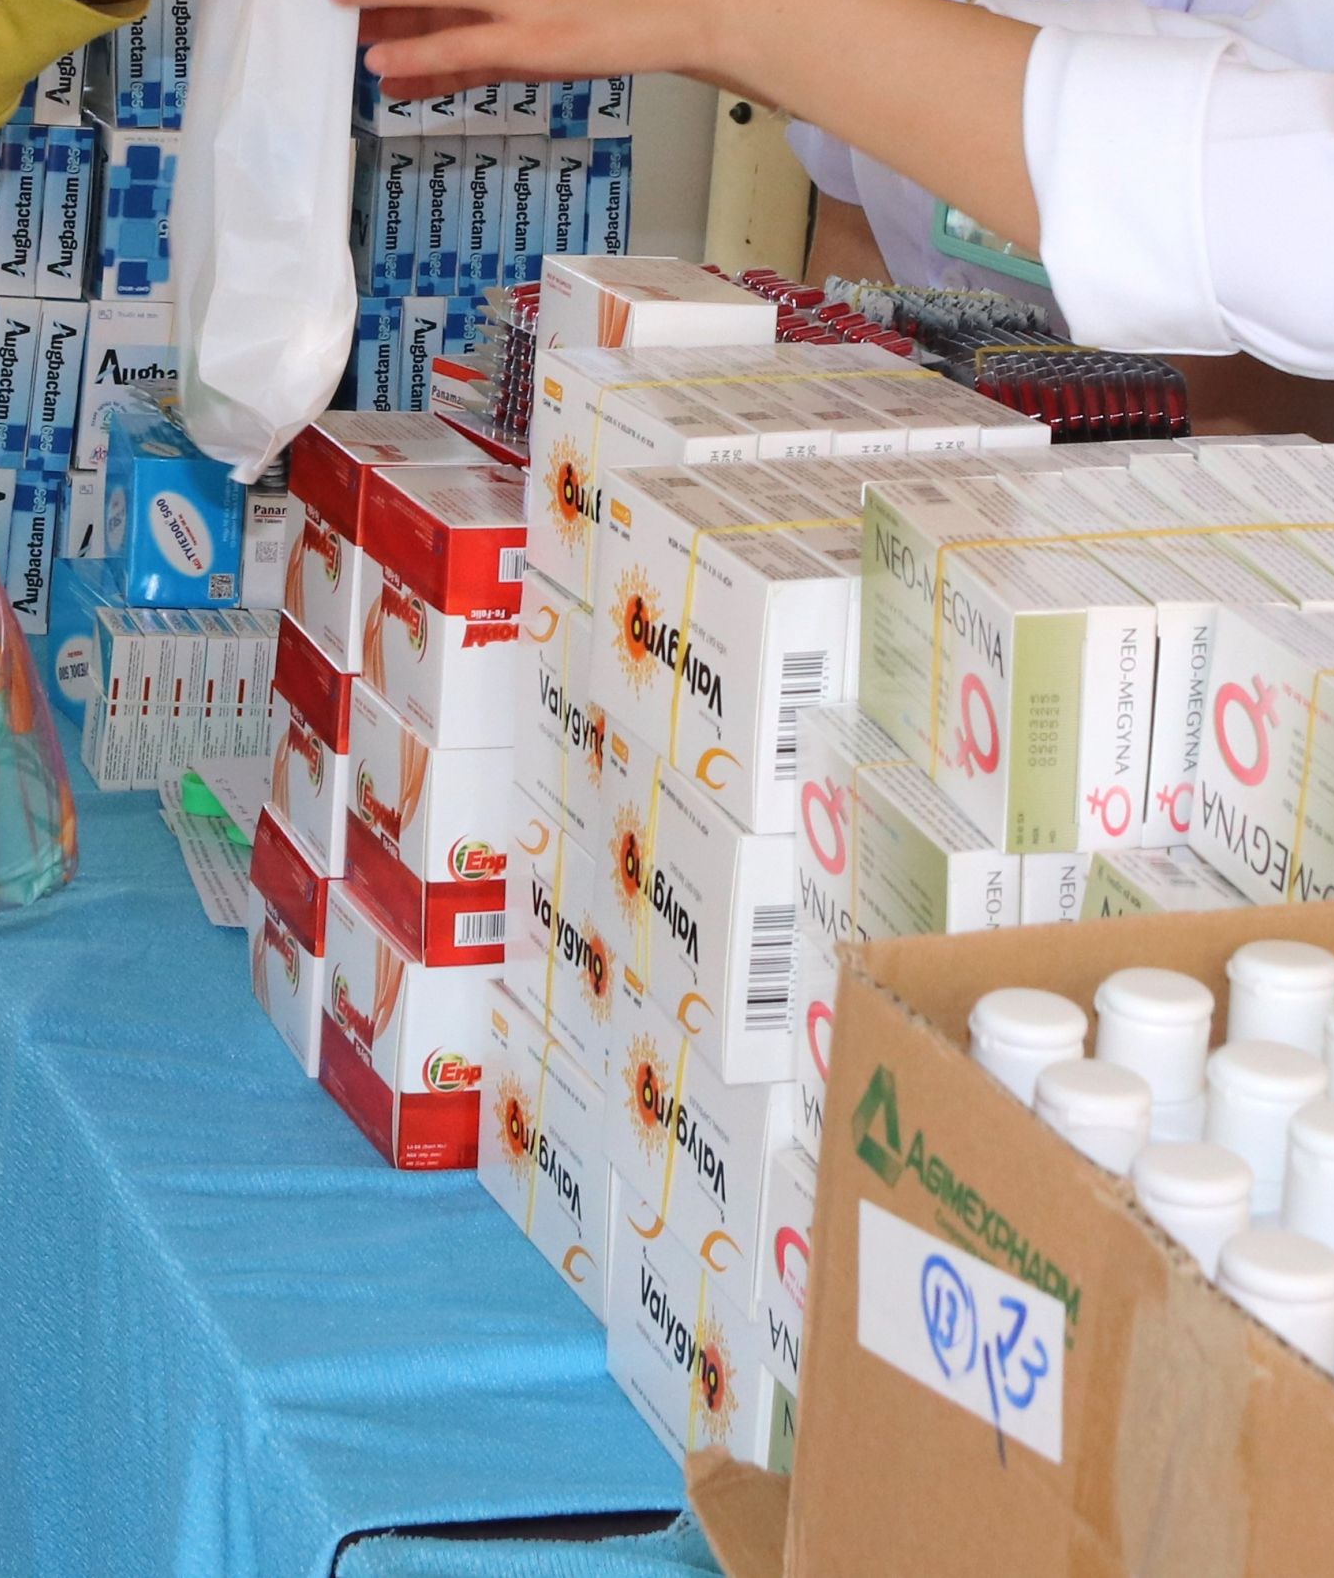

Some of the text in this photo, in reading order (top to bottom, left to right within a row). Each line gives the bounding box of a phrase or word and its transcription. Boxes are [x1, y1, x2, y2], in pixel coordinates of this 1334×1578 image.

[130, 16, 148, 108] bactam 625
[1, 146, 35, 278] Augbactam 625
[47, 147, 82, 279] Augbactam 625
[384, 152, 413, 279] Augbactam 625
[429, 151, 457, 278] Augbactam 625
[470, 153, 498, 279] Augbactam 625
[513, 155, 540, 280] Augbactam 625
[555, 156, 582, 253] Augbactam
[606, 180, 622, 256] ugbactam
[39, 321, 78, 452] Augbactam 625
[373, 316, 391, 412] gbactam 625
[12, 487, 47, 617] Augbactam 625
[155, 497, 173, 520] 500
[1114, 627, 1139, 776] NEO-MEGYNA
[1182, 625, 1209, 773] NEO-MEGYNA
[531, 879, 603, 997] Vaygyno
